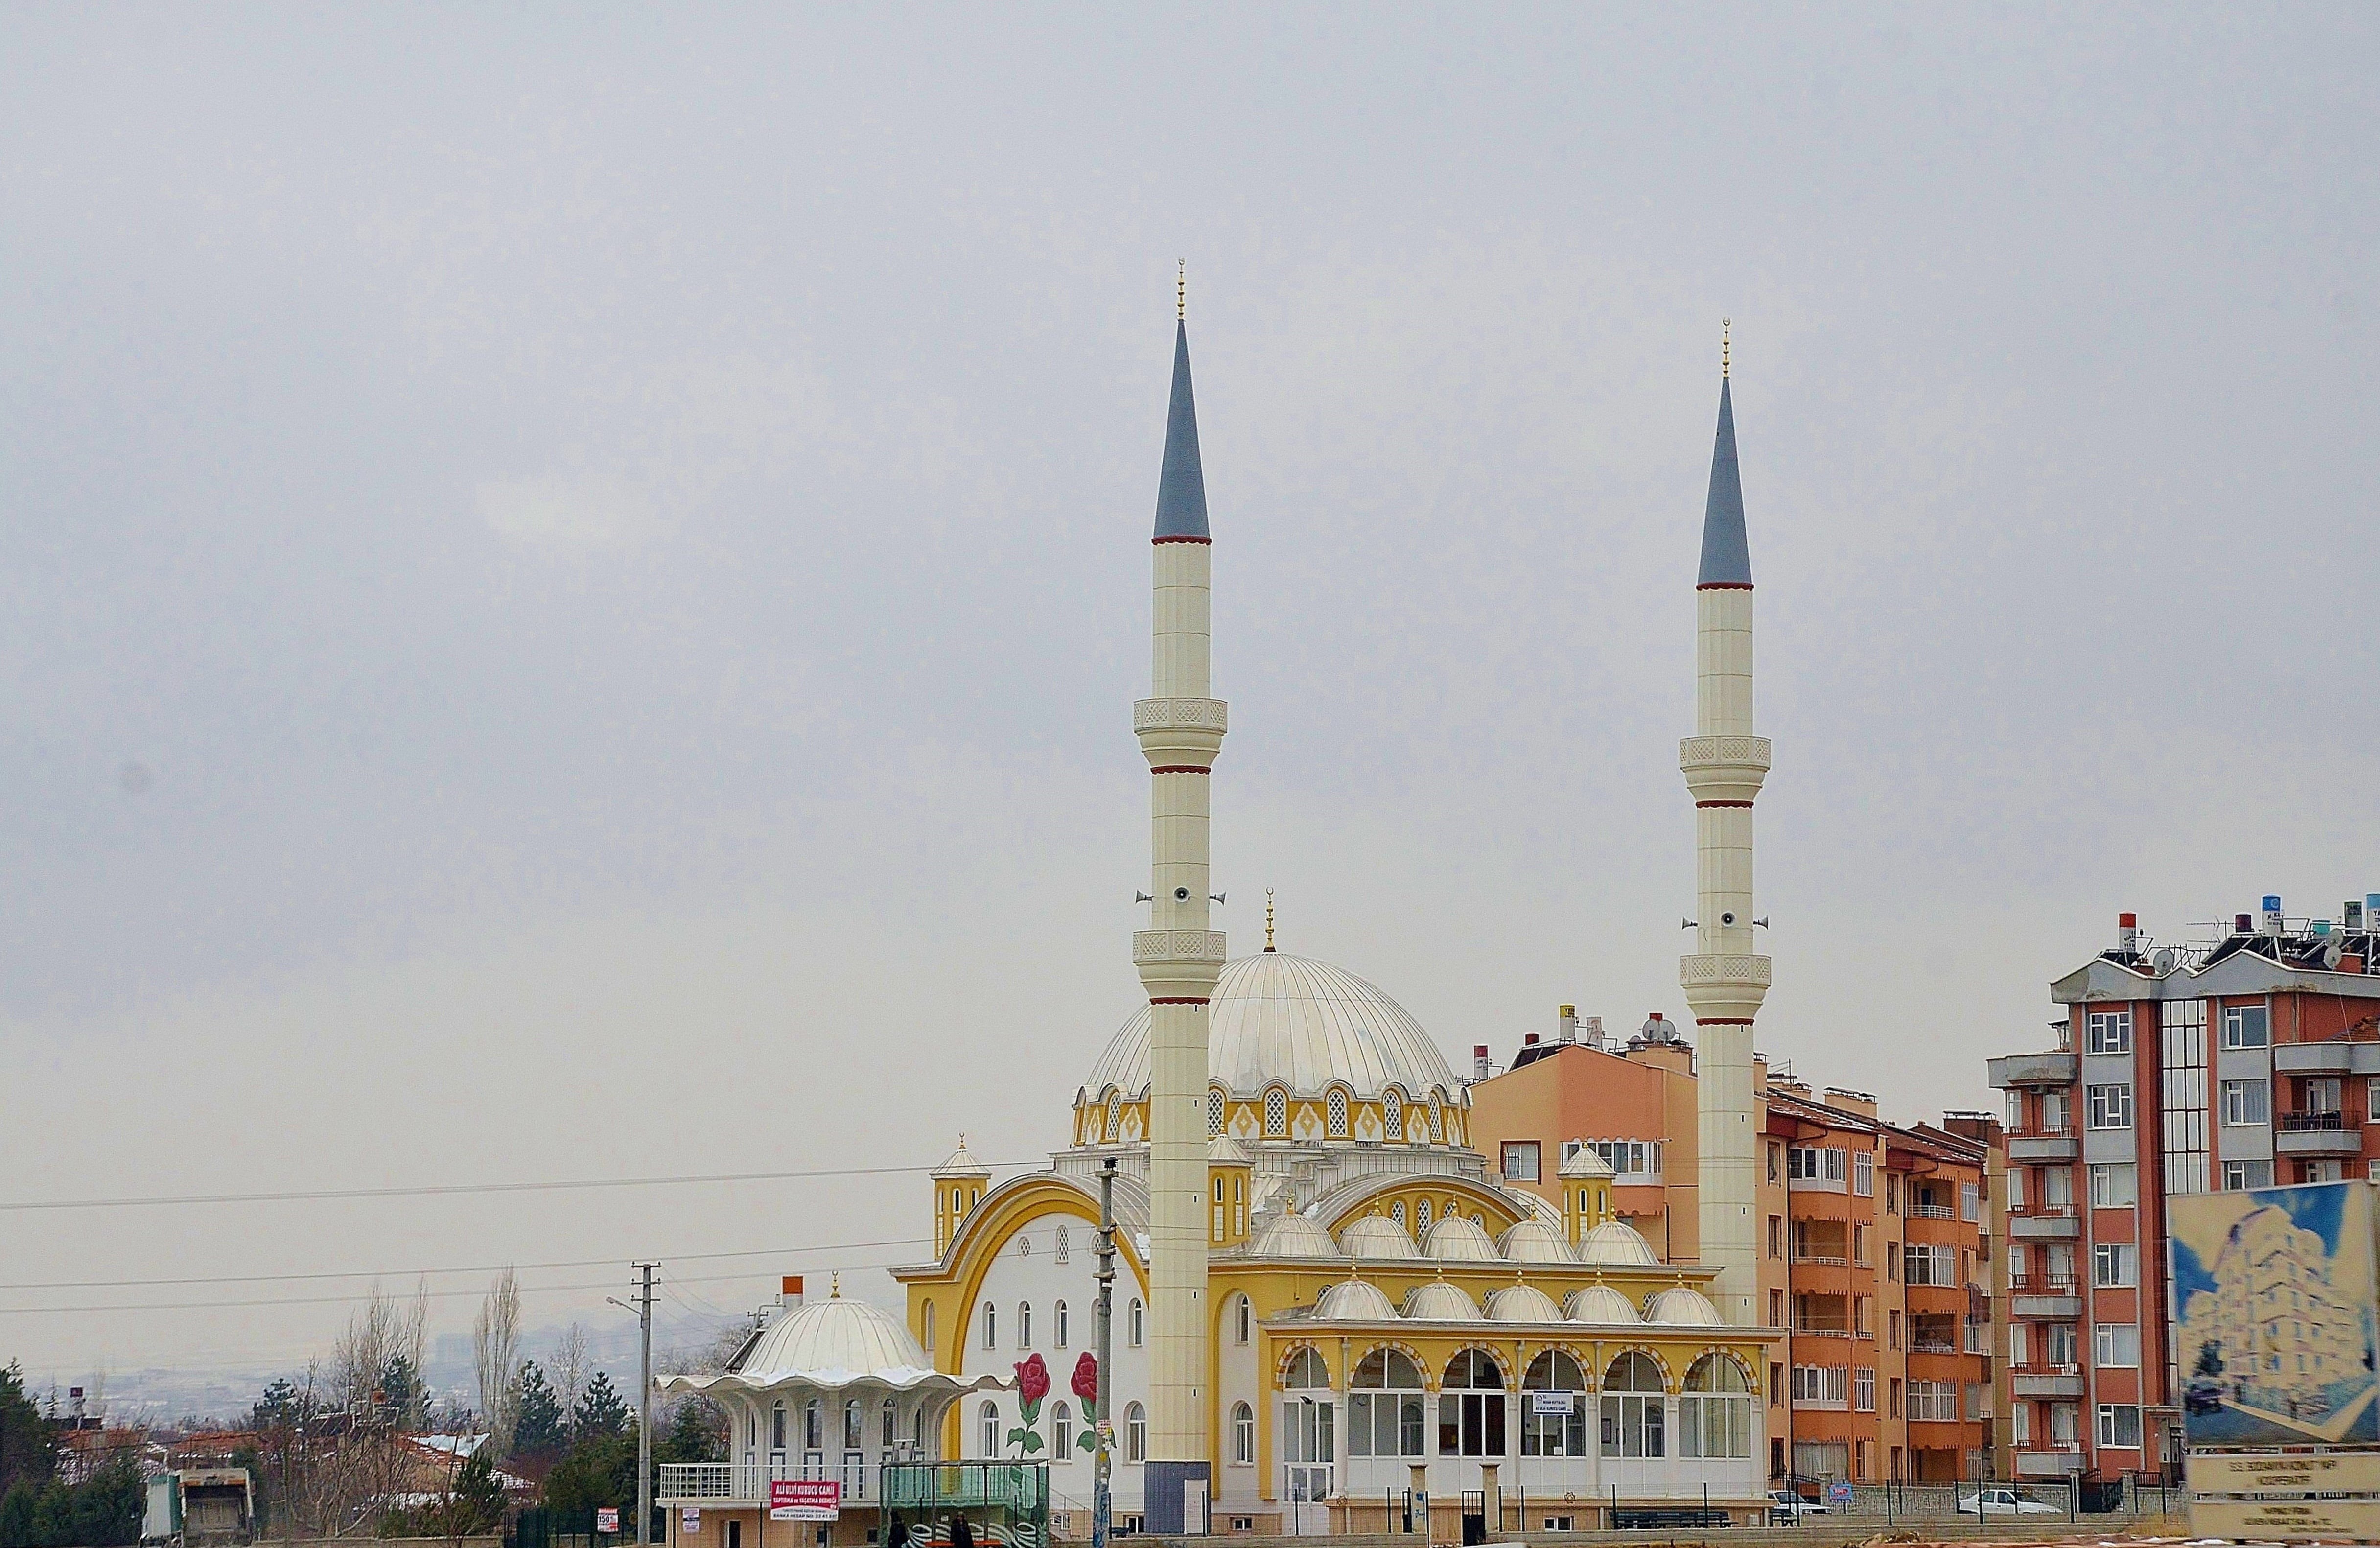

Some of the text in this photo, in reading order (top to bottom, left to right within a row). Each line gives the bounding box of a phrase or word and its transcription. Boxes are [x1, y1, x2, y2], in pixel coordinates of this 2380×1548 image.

[775, 1483, 785, 1495] ALİ
[786, 1483, 797, 1495] ULVİ
[797, 1485, 818, 1496] KURUCU
